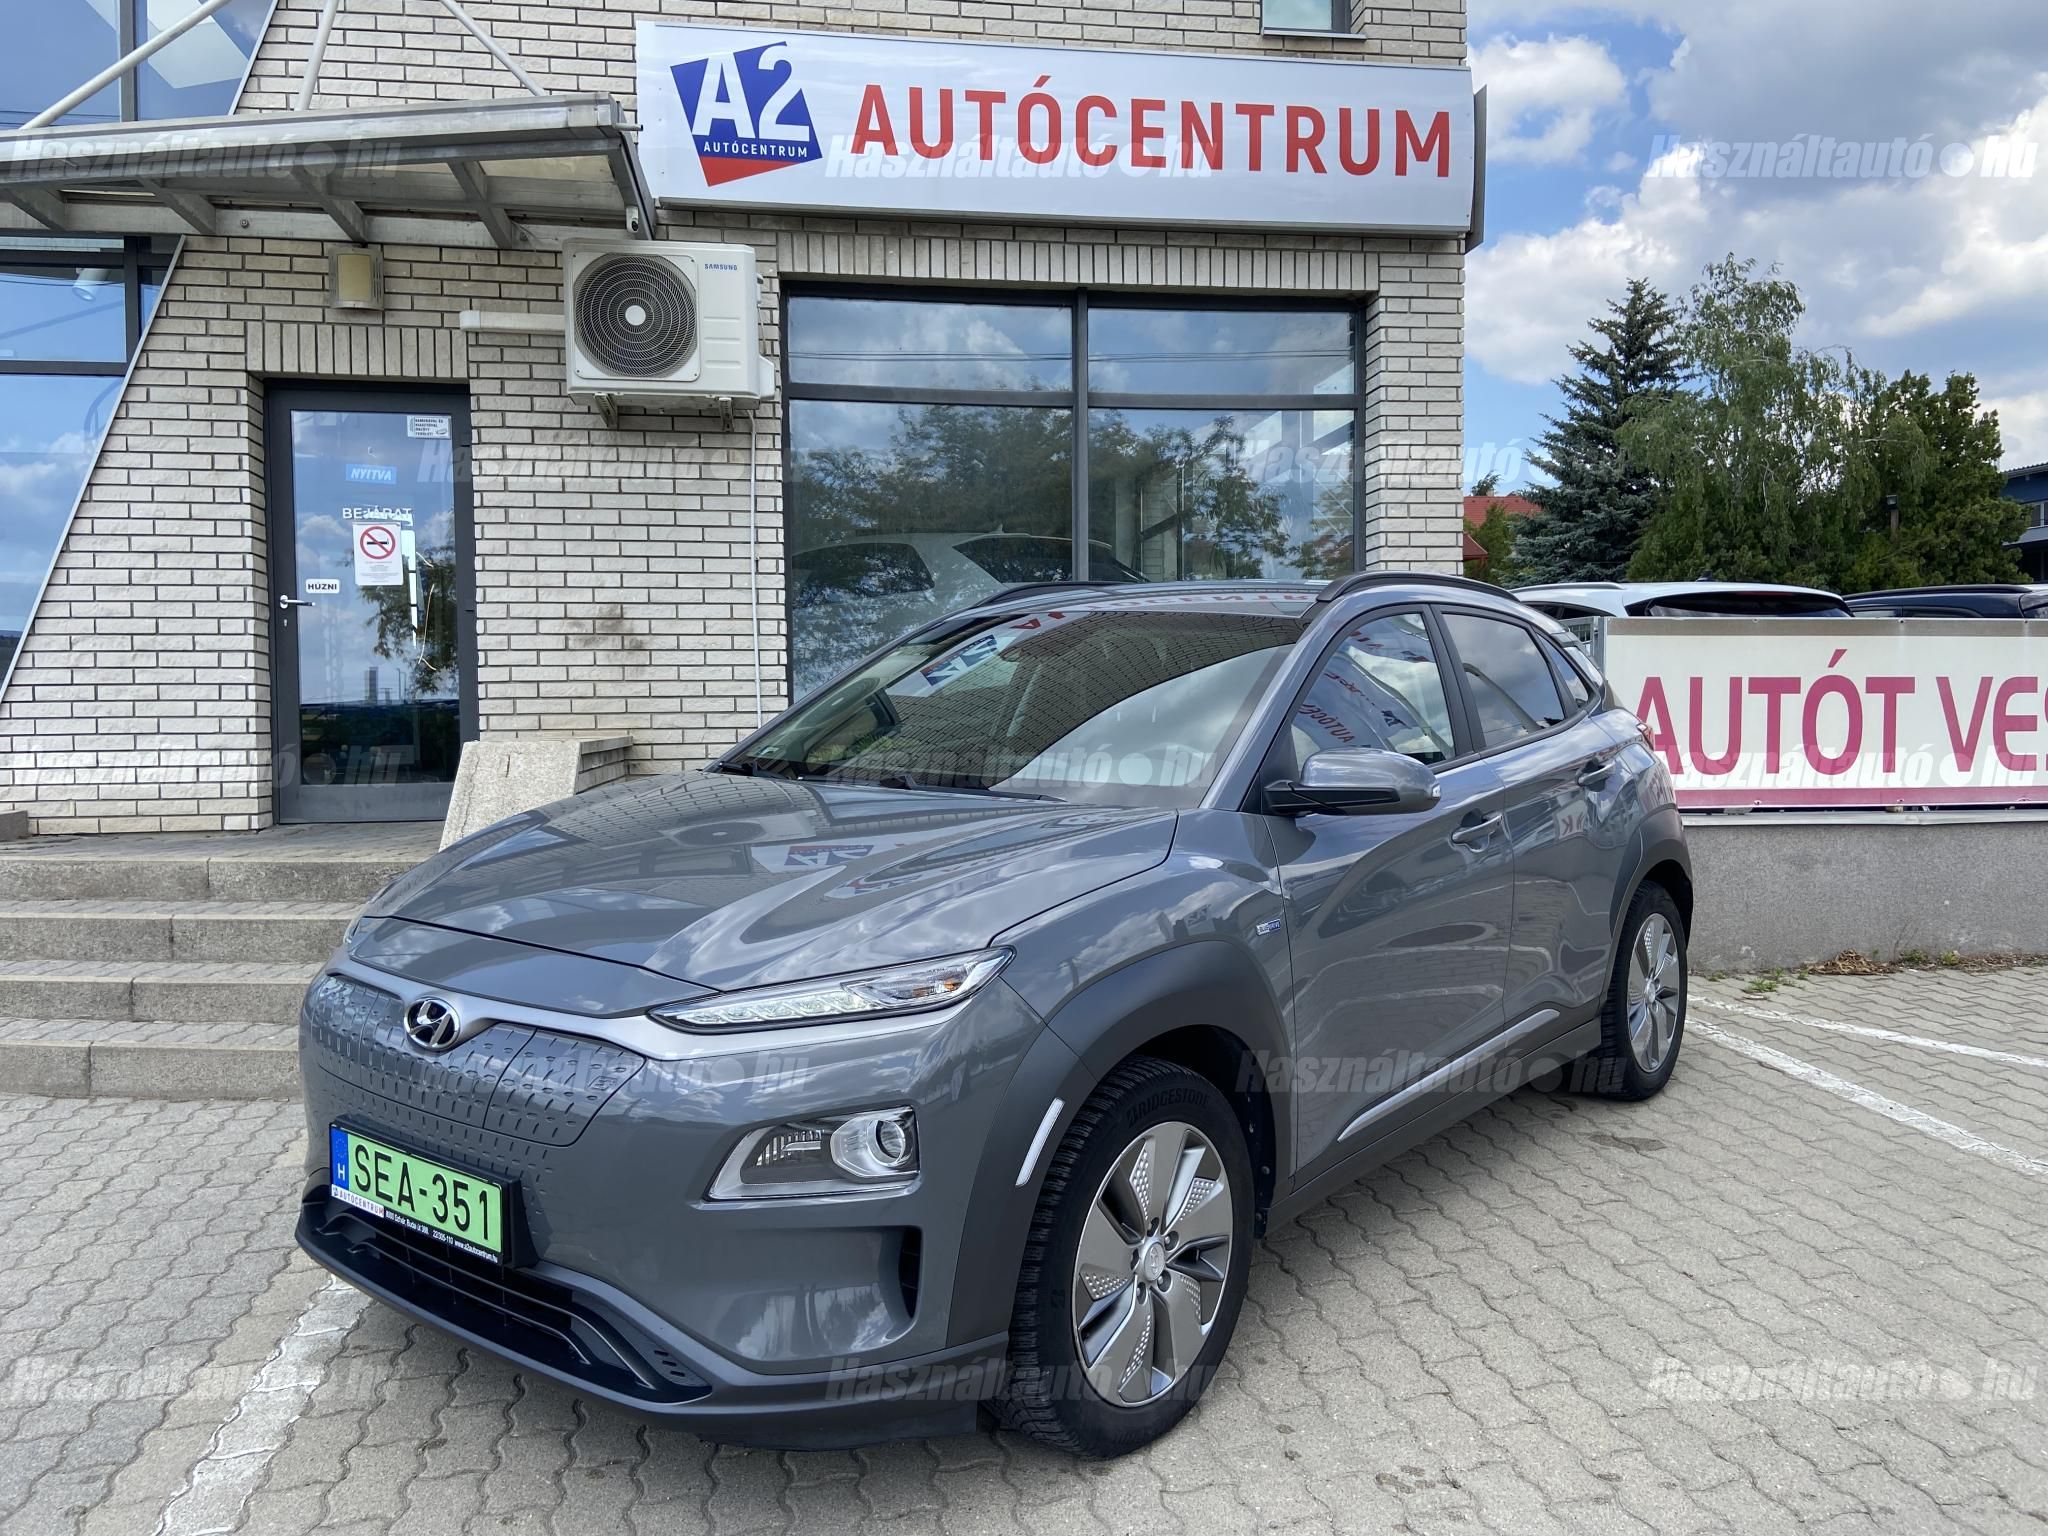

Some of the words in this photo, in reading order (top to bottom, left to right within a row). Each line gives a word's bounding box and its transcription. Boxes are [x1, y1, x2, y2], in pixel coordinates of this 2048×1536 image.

[691, 41, 812, 140] A2
[851, 75, 1450, 179] AUTÓCENTRUM
[703, 140, 809, 161] AUTÓCENTRUM
[704, 263, 738, 271] SAMSUNG
[351, 467, 392, 481] NYITVA
[307, 581, 338, 591] HÚZNI
[1636, 649, 1915, 775] AUTÓT
[1936, 676, 2048, 773] VE
[337, 1163, 346, 1181] H
[354, 1144, 489, 1240] SEA-351
